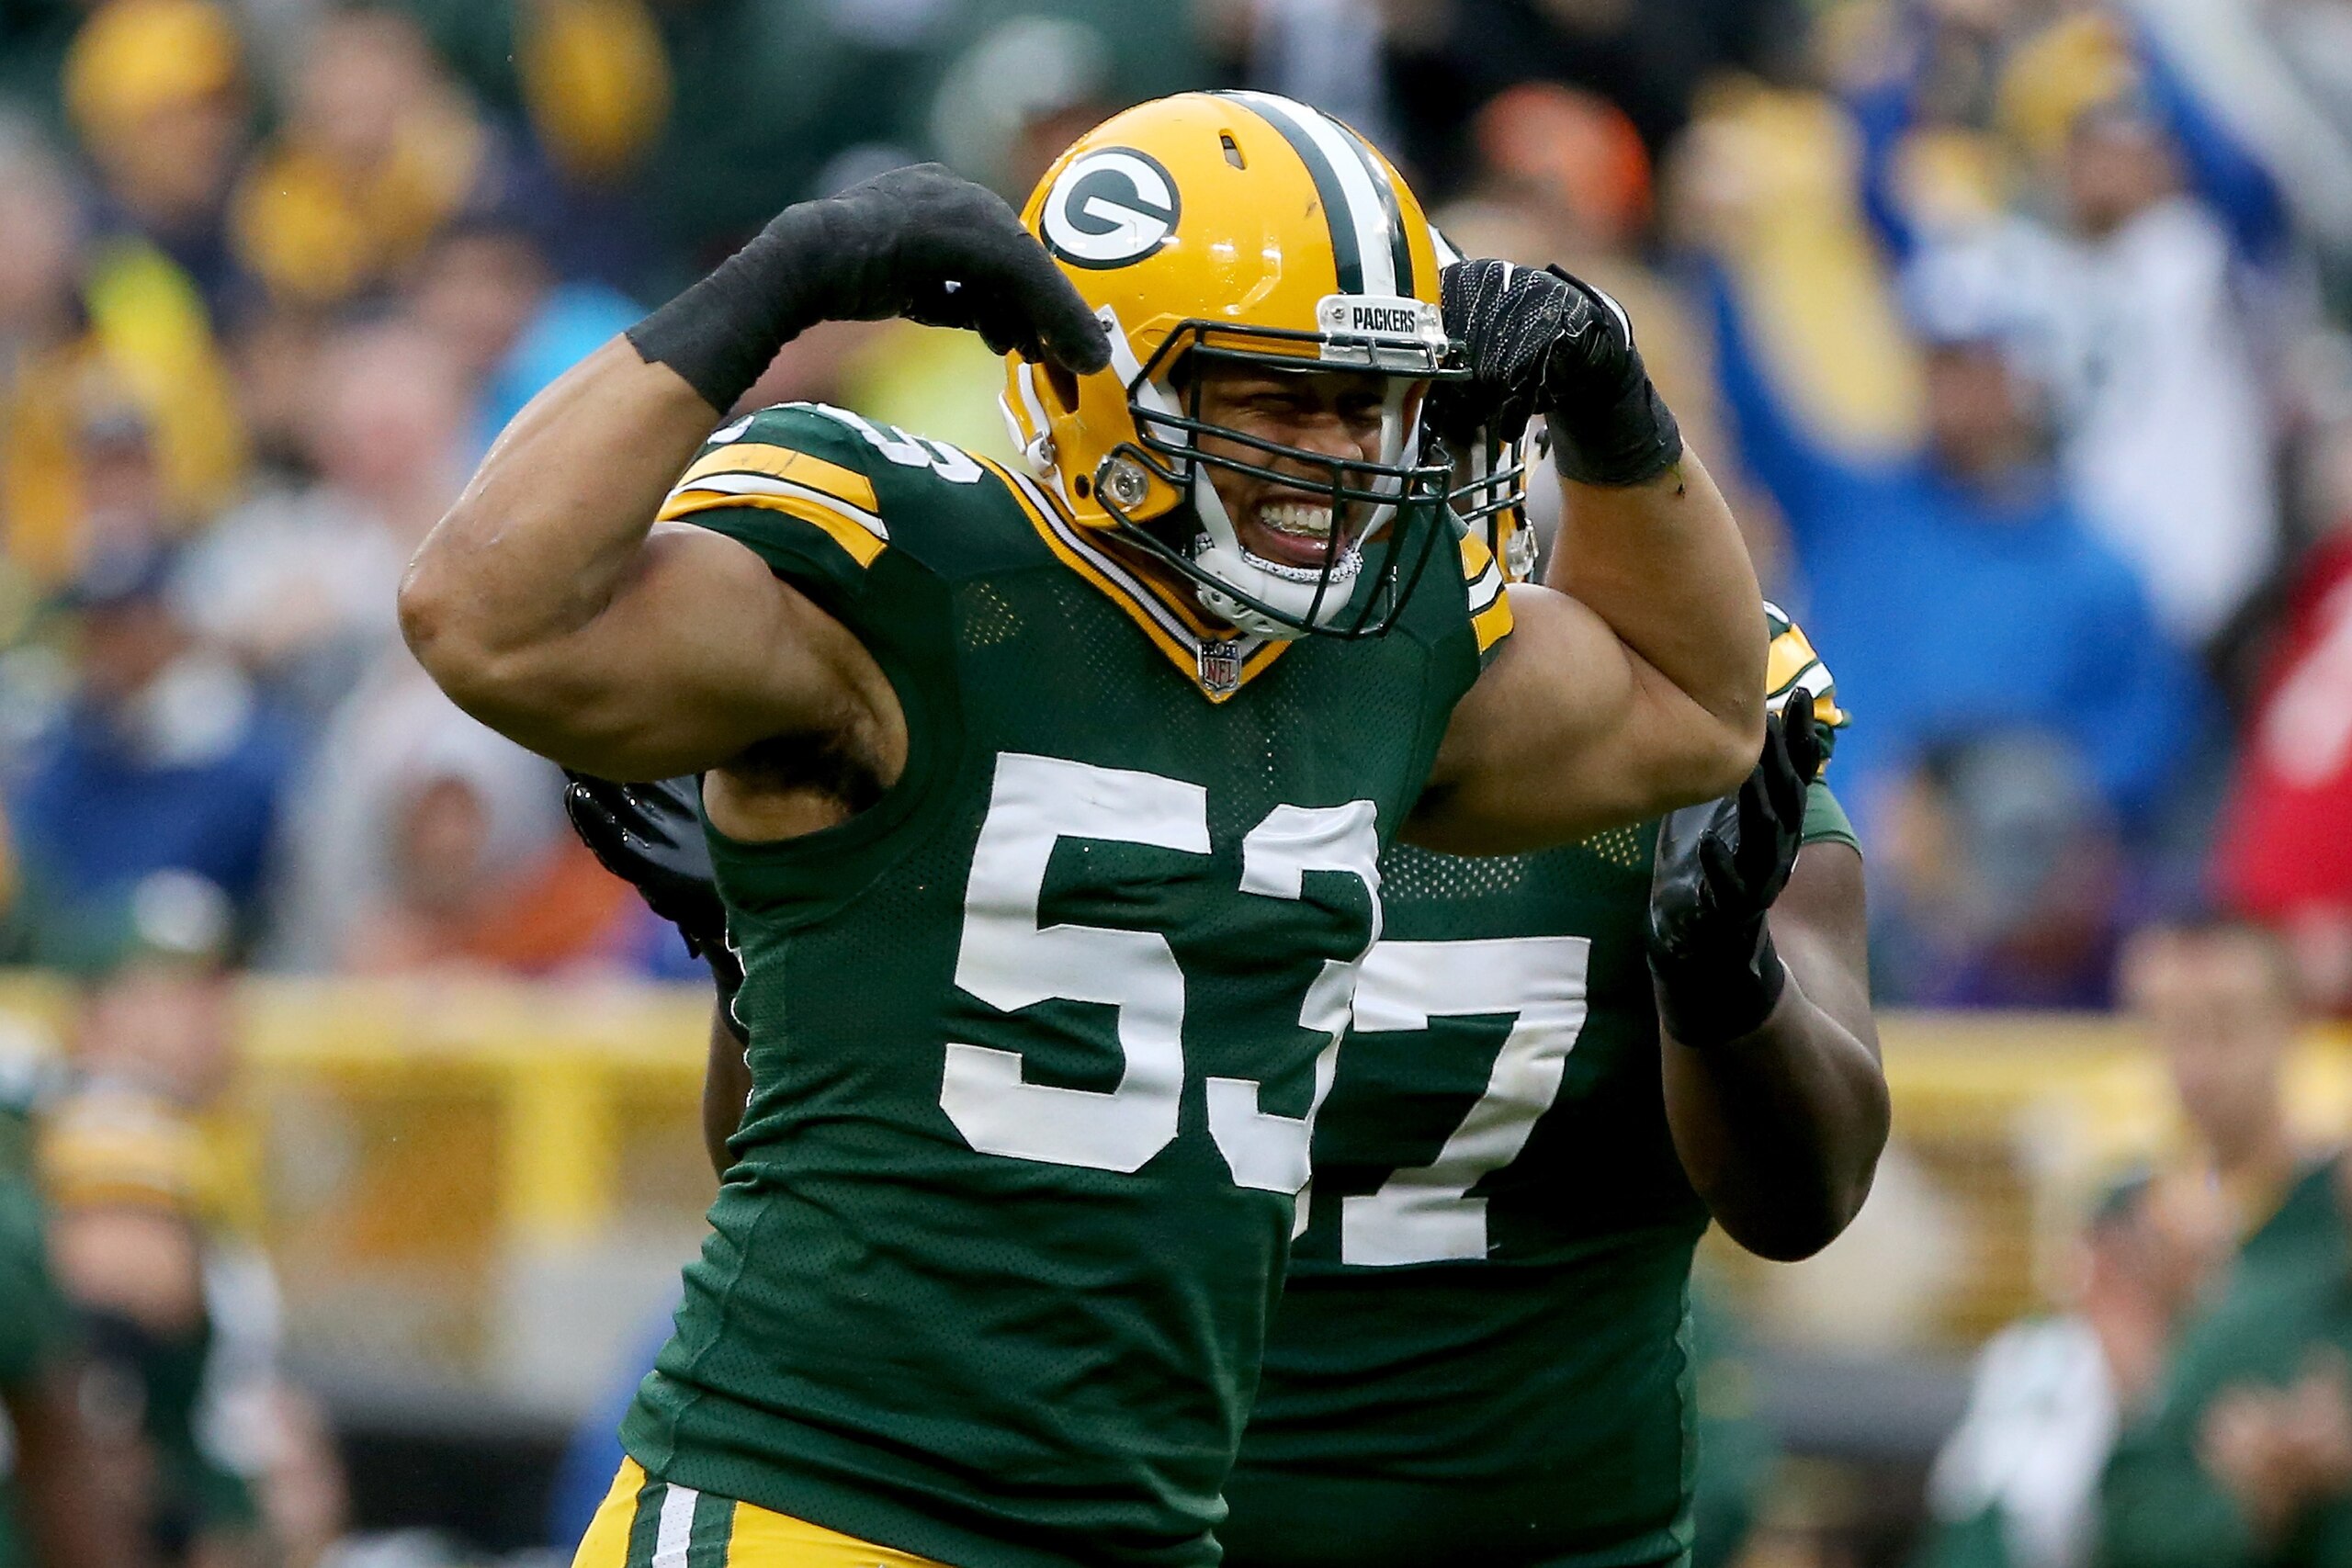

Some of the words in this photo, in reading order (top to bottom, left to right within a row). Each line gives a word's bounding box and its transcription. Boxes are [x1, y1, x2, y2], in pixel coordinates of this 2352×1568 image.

[1043, 152, 1173, 261] G
[1352, 307, 1415, 333] PACKERS
[1205, 658, 1236, 684] NFL
[939, 751, 1384, 1195] 53
[1291, 937, 1591, 1267] 7
